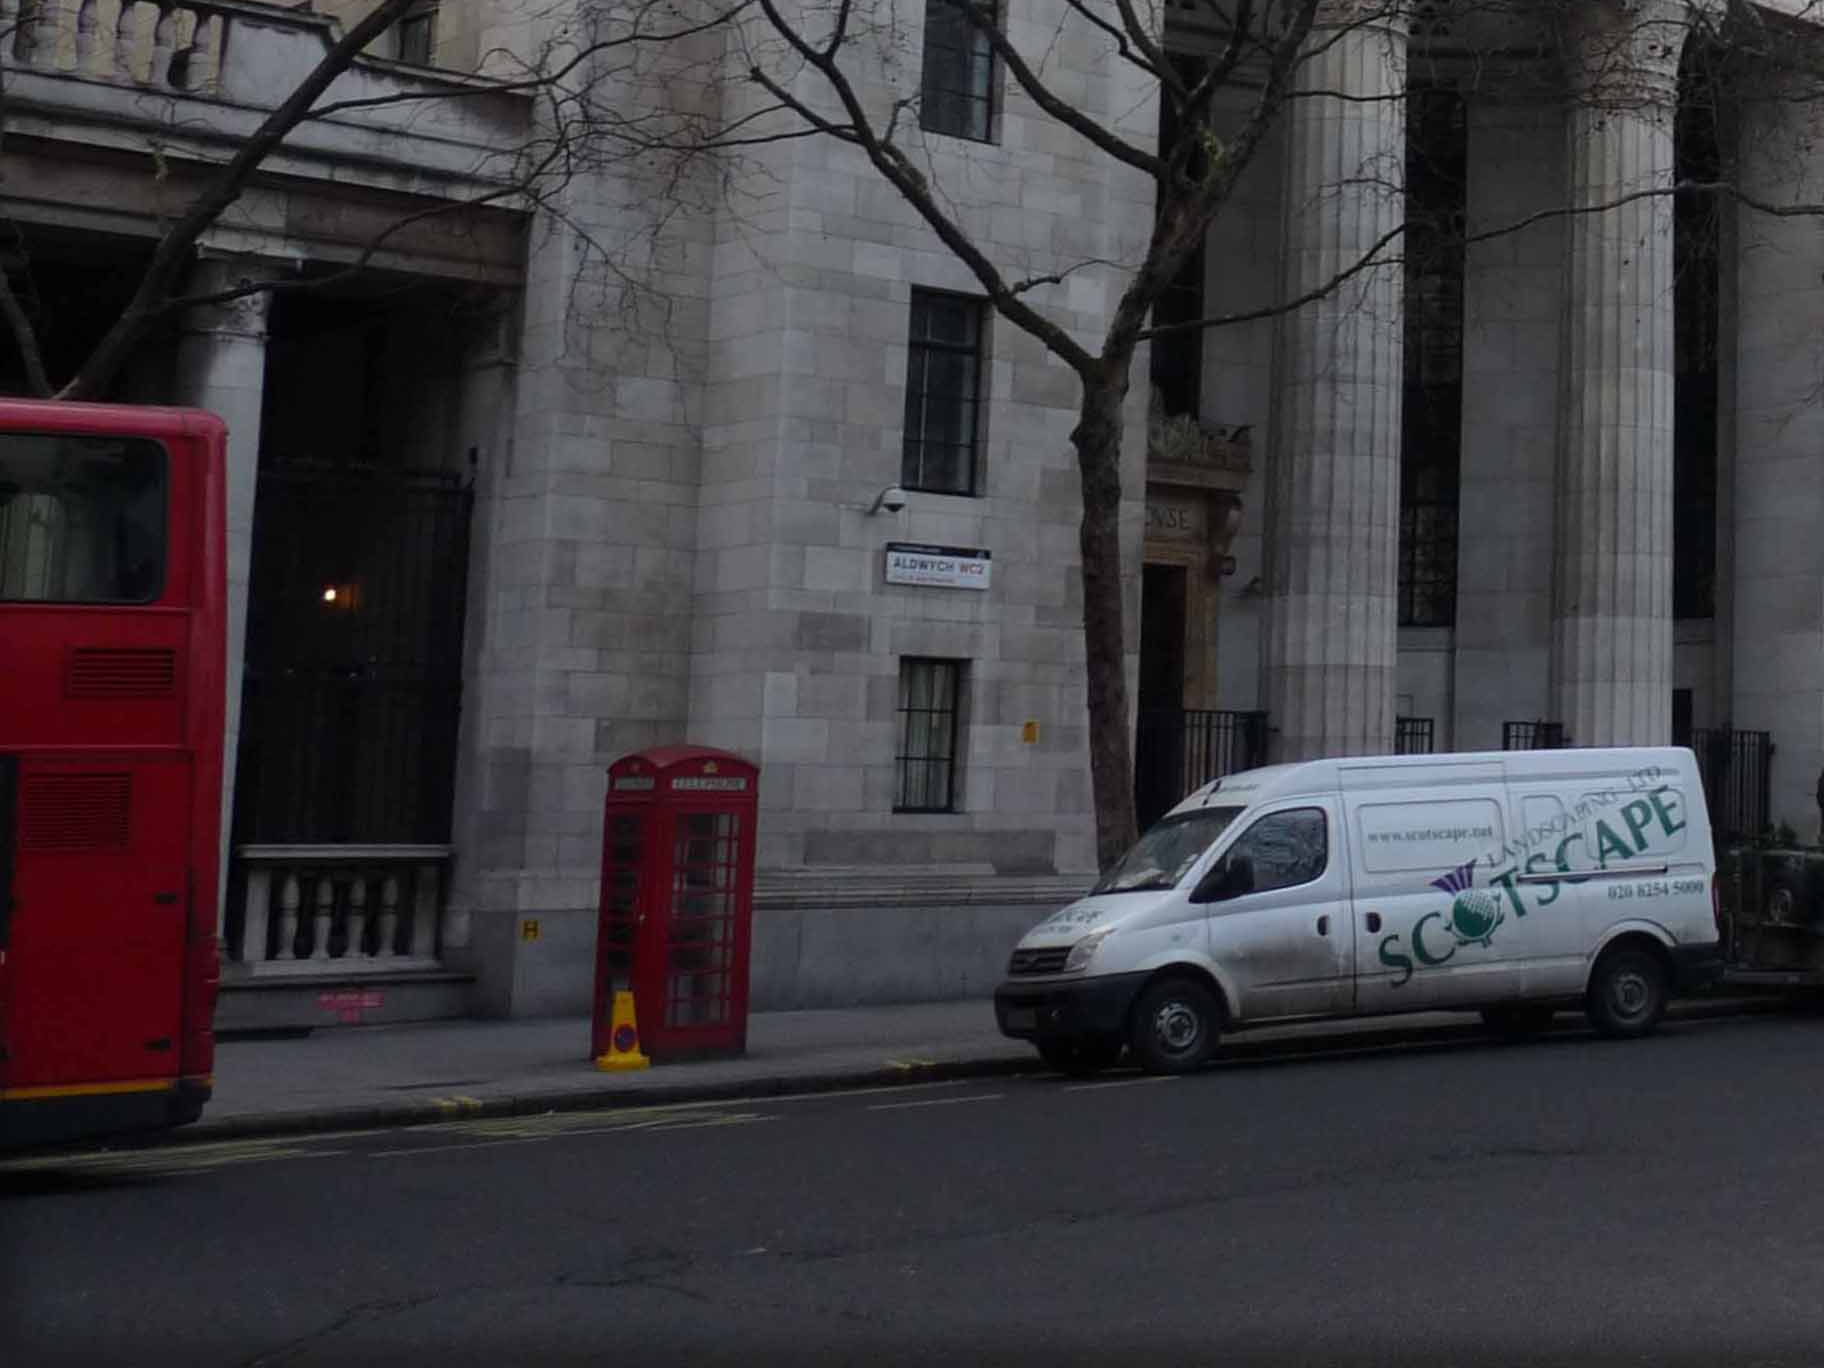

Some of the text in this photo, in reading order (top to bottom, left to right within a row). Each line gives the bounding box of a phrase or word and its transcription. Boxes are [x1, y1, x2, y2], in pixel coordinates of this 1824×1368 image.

[894, 556, 984, 576] ALDWYCH WC2
[1607, 879, 1704, 900] 020 8254 5000
